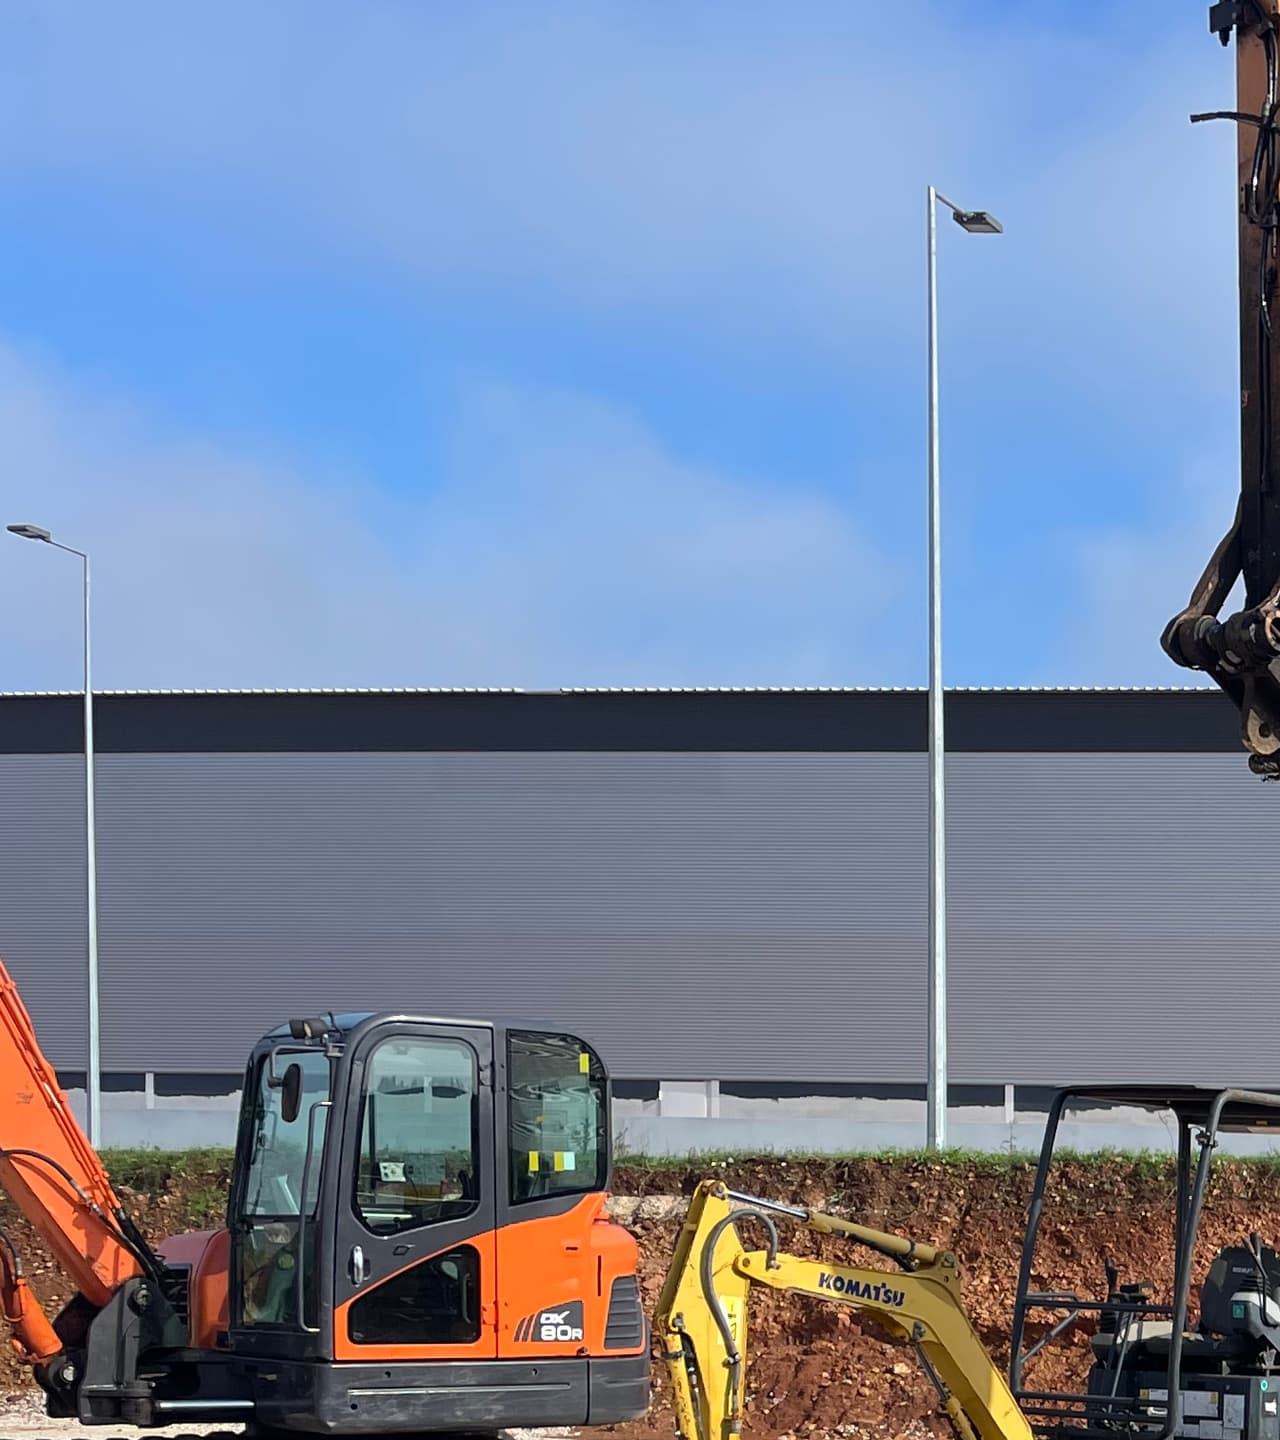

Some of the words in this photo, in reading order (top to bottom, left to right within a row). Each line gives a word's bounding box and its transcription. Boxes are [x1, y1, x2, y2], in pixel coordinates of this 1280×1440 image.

[818, 1272, 905, 1306] KOMATSU
[540, 1311, 570, 1324] DX
[541, 1325, 583, 1341] 80R
